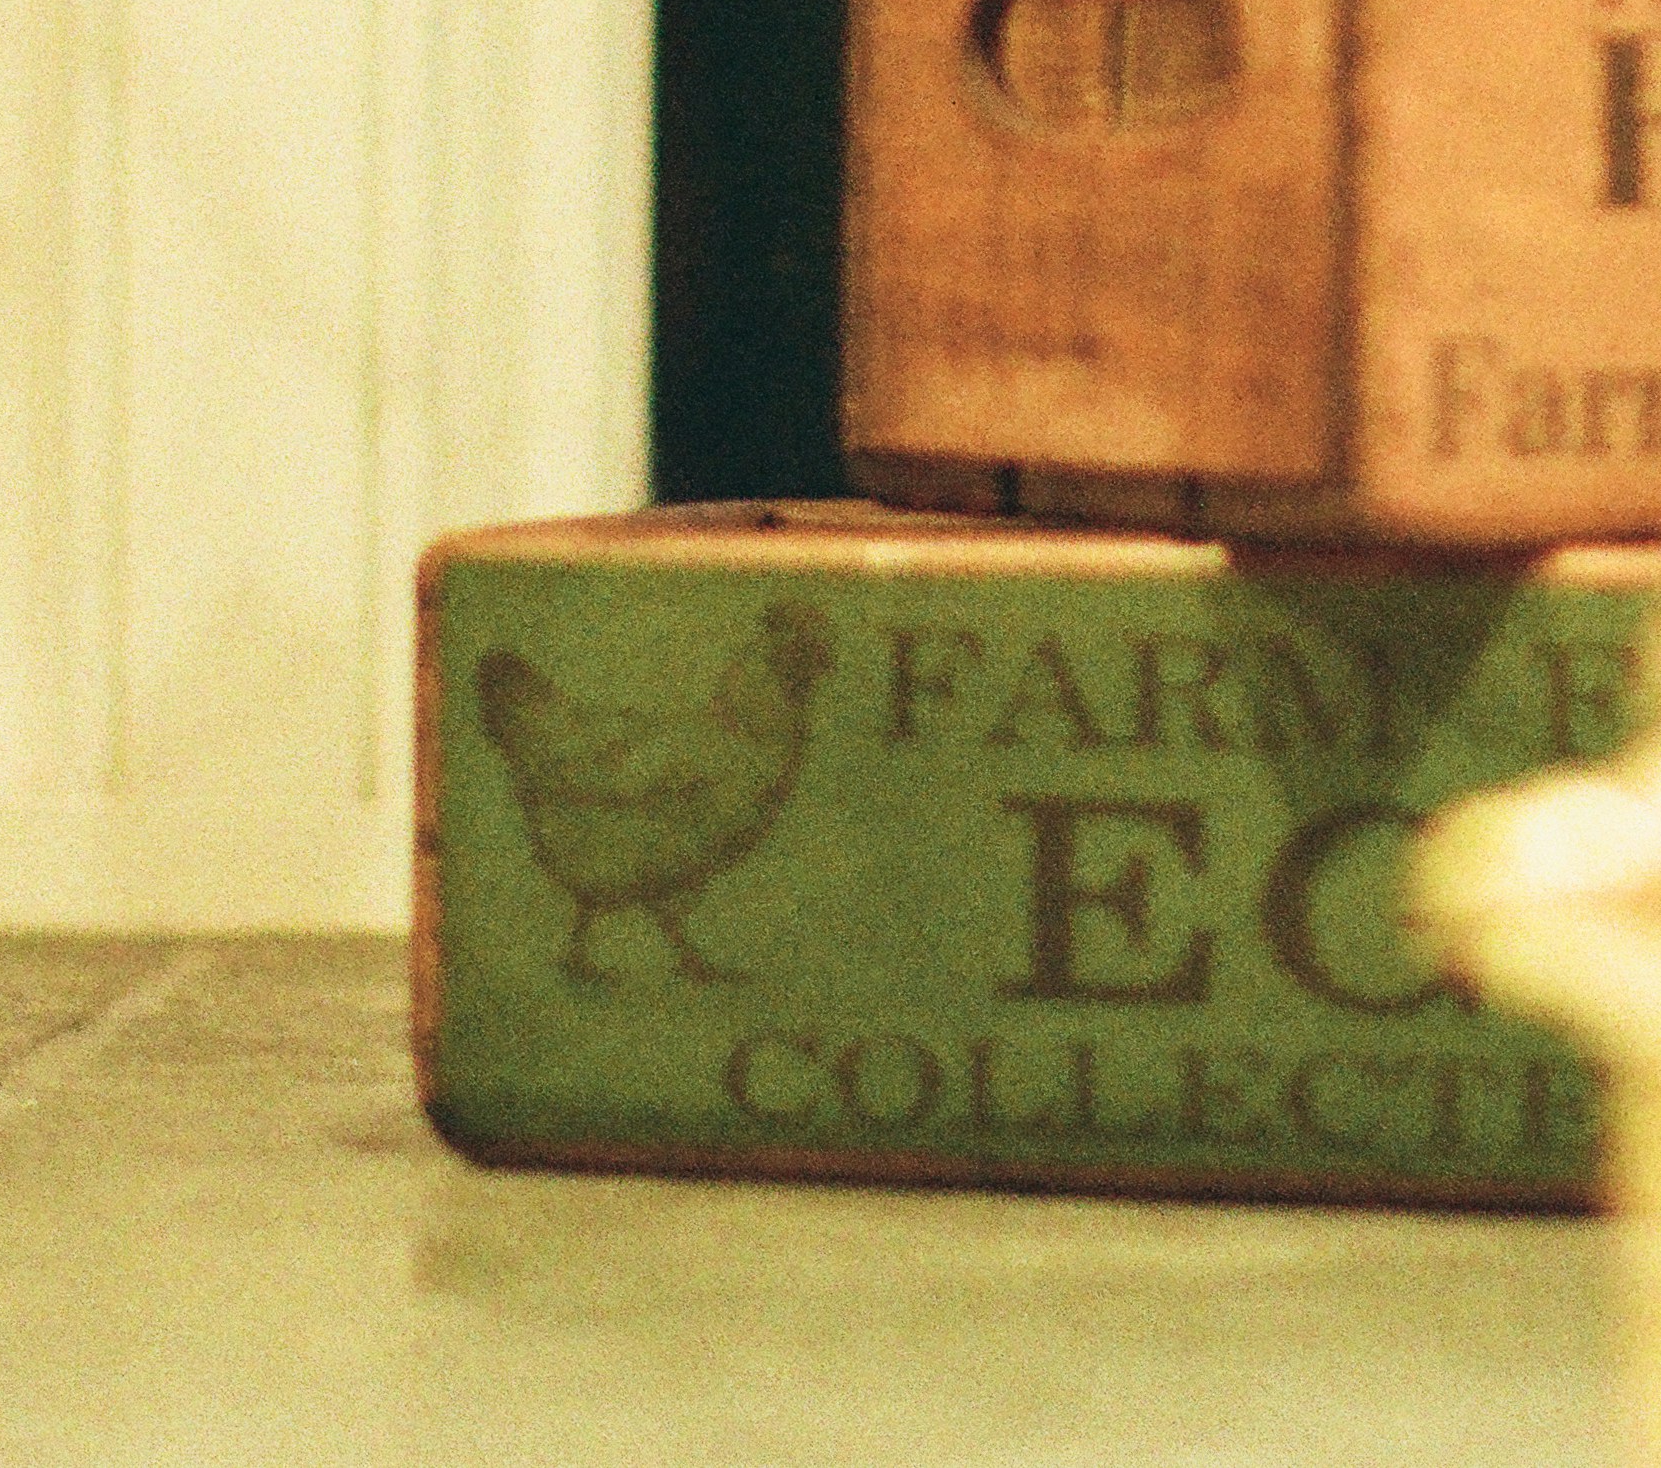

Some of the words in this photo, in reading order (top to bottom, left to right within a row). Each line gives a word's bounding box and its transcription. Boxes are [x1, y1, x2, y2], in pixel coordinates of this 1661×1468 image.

[880, 628, 1408, 764] FARM
[992, 790, 1485, 1019] EG
[722, 1028, 1615, 1156] COLLECTE
